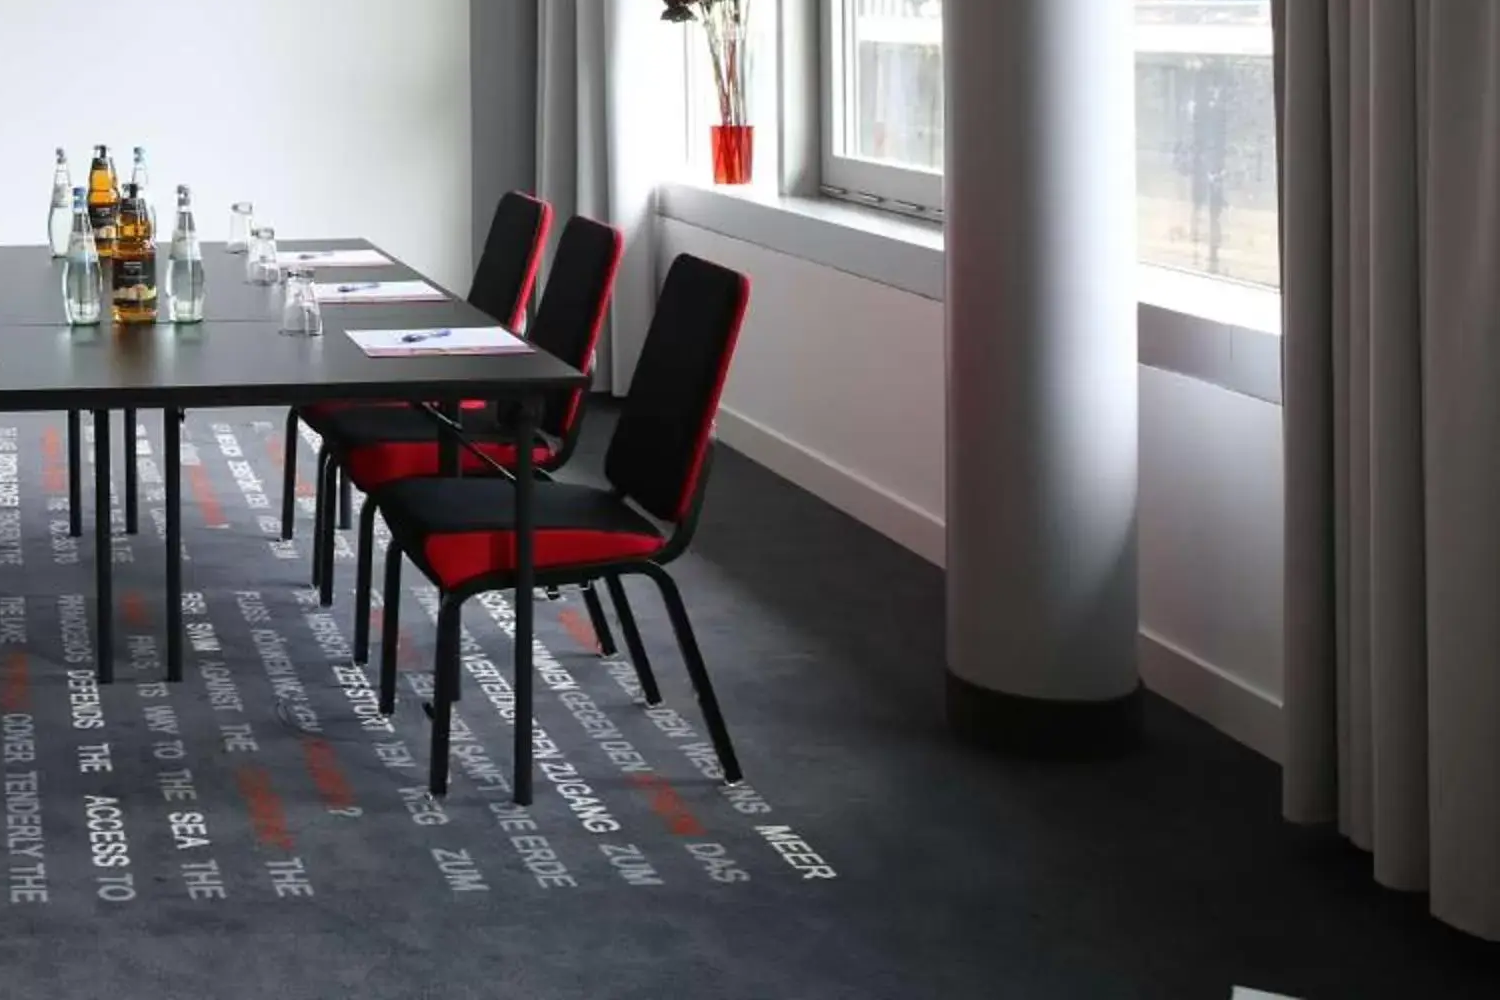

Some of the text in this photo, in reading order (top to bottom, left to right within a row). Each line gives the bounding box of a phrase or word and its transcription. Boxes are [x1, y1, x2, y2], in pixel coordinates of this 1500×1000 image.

[68, 670, 103, 728] DEFENDS
[146, 705, 178, 732] WAY
[3, 713, 35, 761] COVER
[78, 744, 111, 772] THE
[154, 740, 185, 758] TO
[160, 769, 196, 799] THE
[6, 771, 43, 857] TENDERLY
[170, 812, 211, 848] SEA
[224, 722, 259, 750] THE
[266, 857, 312, 896] THE
[329, 805, 363, 817] ?
[538, 762, 622, 832] ZUGANG
[599, 843, 664, 884] ZUM
[598, 741, 654, 771] DEN
[682, 843, 752, 882] DAS
[85, 795, 129, 867] ACCESS
[753, 825, 840, 878] MEER
[181, 860, 224, 898] THE
[430, 848, 488, 891] ZUM
[508, 835, 575, 887] ERDE
[10, 864, 46, 902] THE
[96, 873, 134, 900] TO
